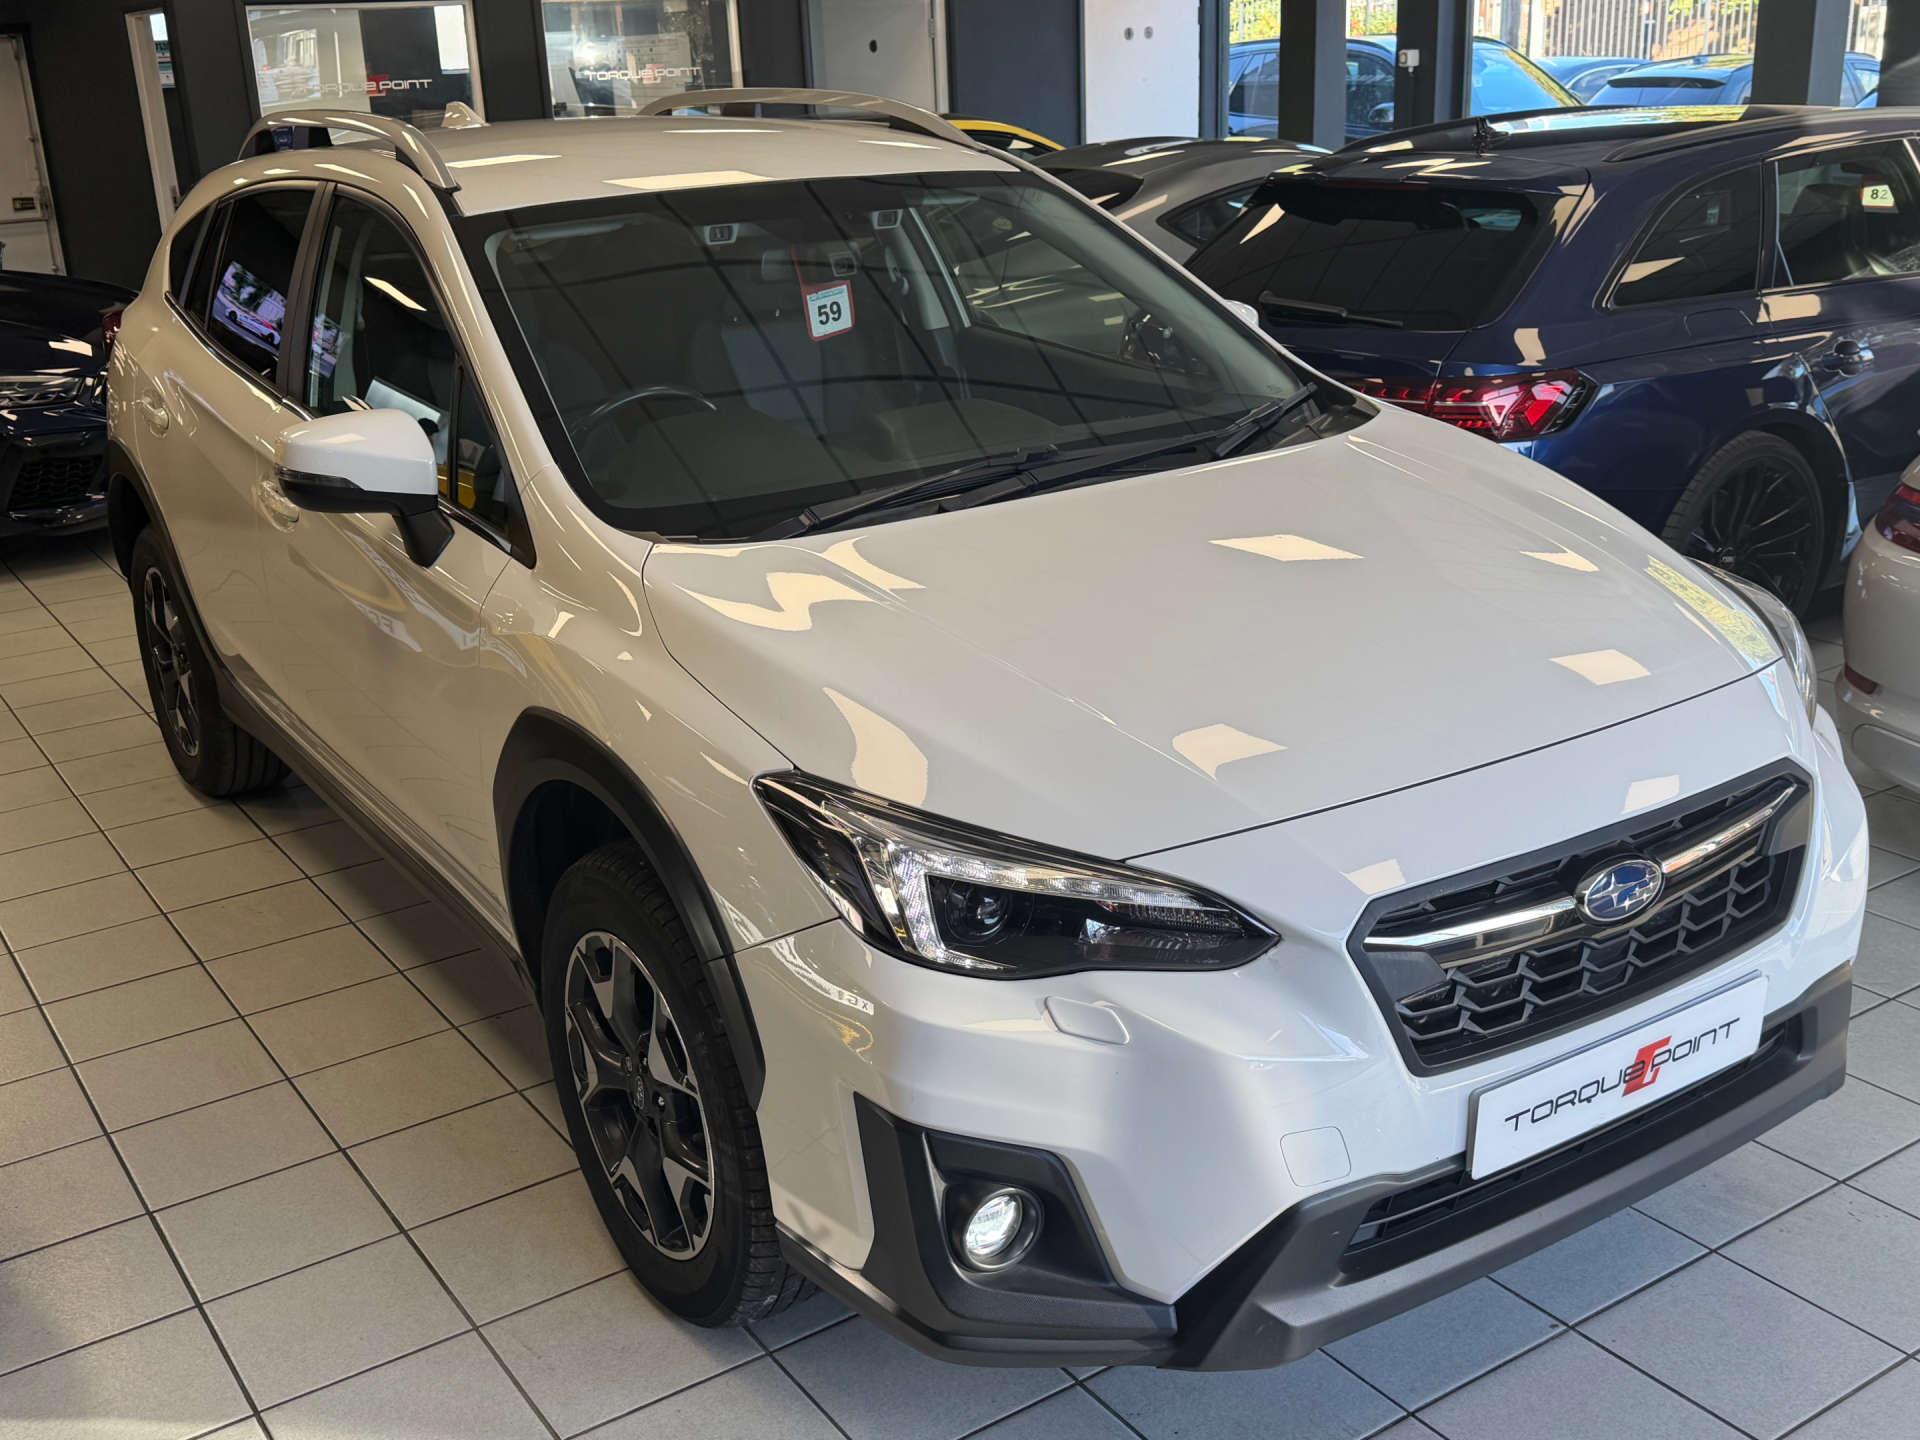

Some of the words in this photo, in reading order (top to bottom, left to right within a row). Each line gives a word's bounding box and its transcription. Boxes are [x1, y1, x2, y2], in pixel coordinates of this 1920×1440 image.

[584, 69, 654, 82] TORQUE
[379, 79, 433, 91] POINT
[1870, 188, 1889, 200] 82
[817, 301, 842, 325] 59
[1504, 1060, 1646, 1131] TORQUE
[1650, 1017, 1741, 1072] POINT
